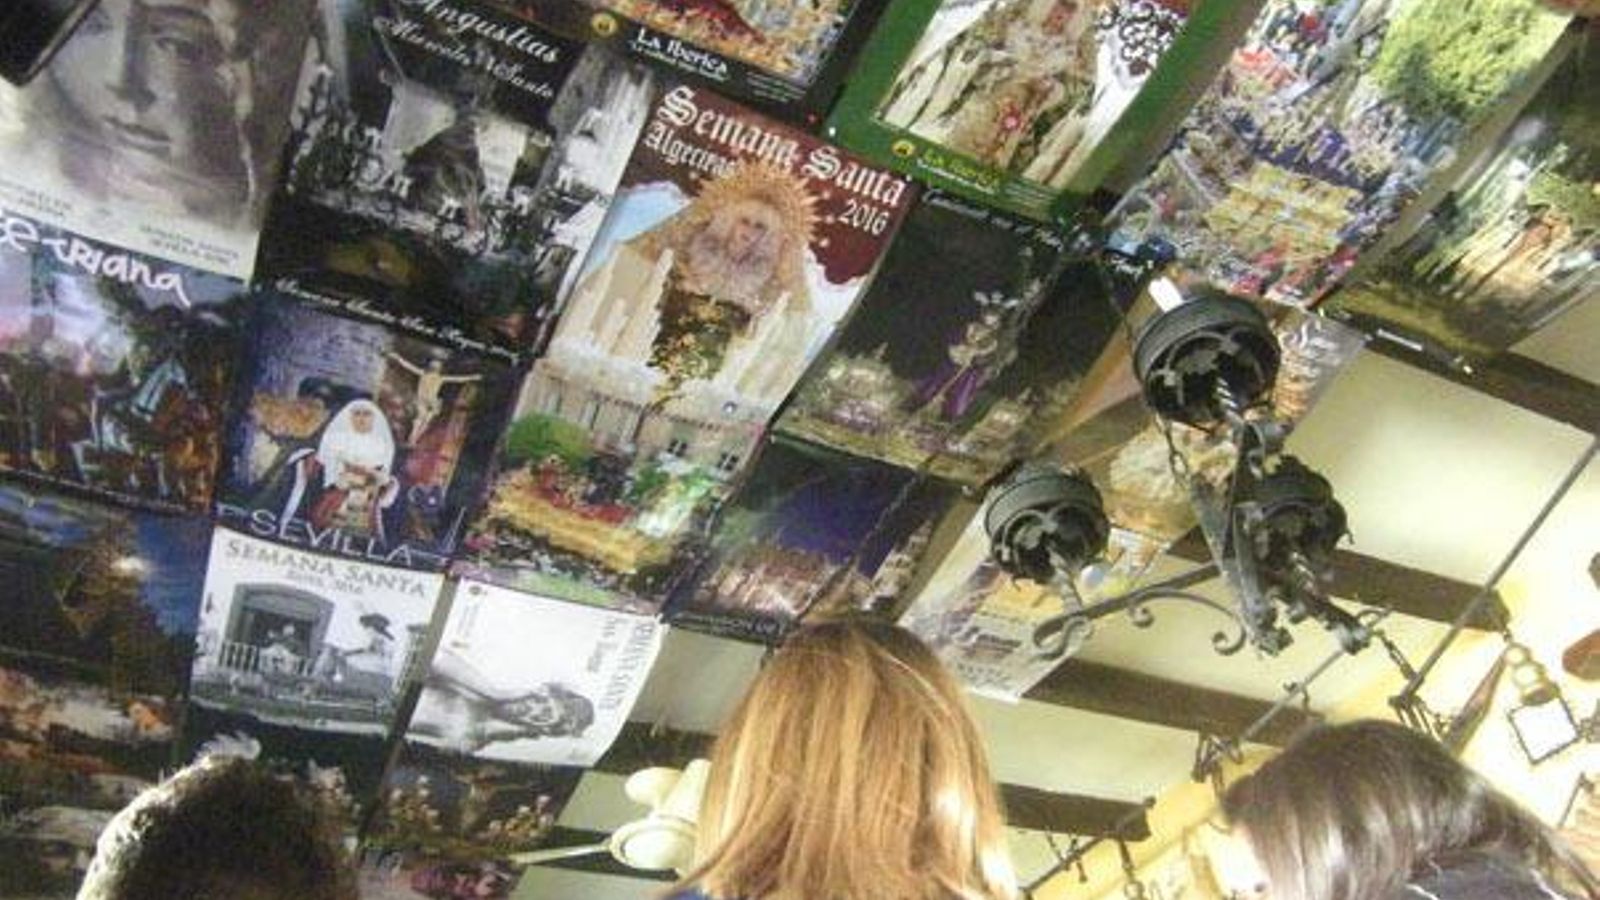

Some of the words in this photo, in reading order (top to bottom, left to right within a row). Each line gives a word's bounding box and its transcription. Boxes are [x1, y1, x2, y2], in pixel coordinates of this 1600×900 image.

[656, 84, 800, 173] Semana
[802, 144, 906, 208] Santa
[838, 198, 890, 236] 2016
[250, 508, 413, 567] SEVILLA
[226, 539, 335, 577] SEMANA
[347, 563, 426, 598] SANTA
